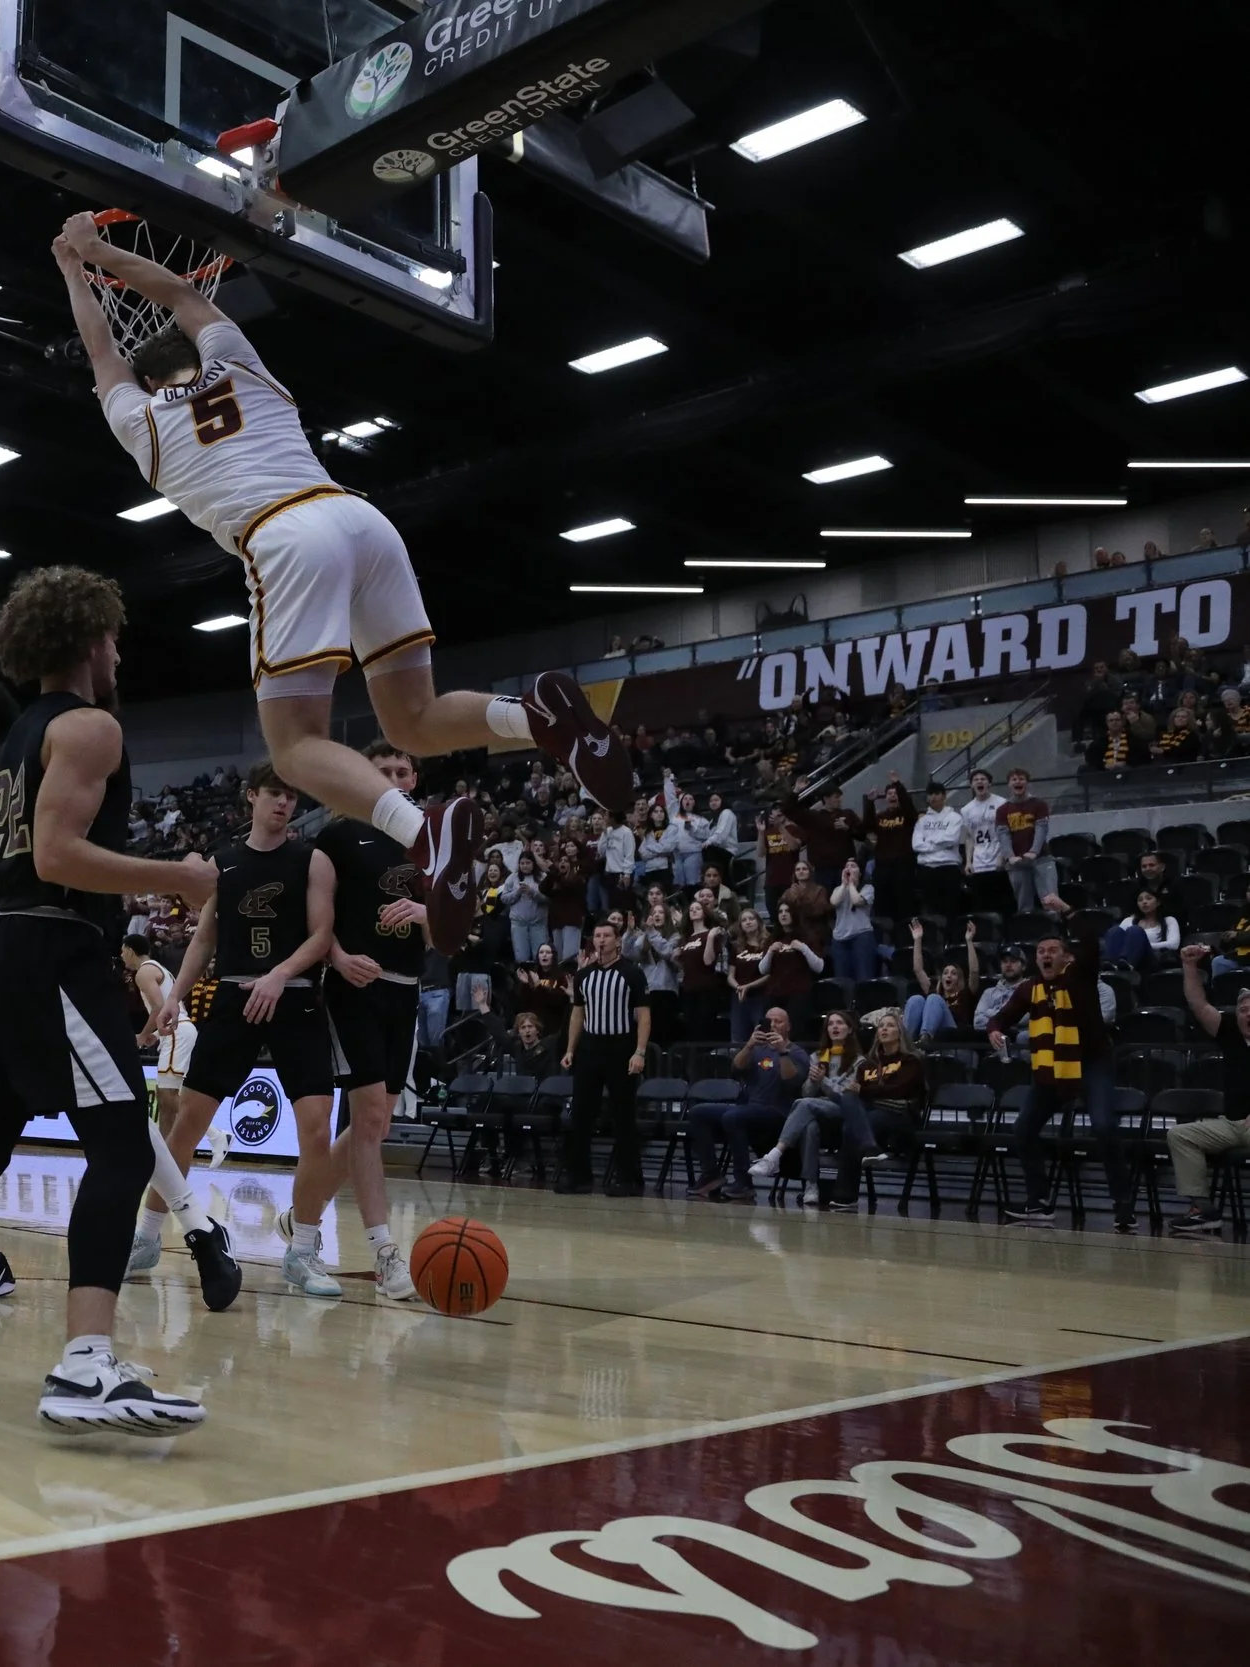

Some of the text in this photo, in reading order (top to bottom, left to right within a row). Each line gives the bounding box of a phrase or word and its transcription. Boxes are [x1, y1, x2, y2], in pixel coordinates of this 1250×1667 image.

[424, 10, 517, 76] CREDIT
[427, 57, 611, 150] GreenState
[449, 80, 602, 157] CREDIT UNION
[190, 376, 245, 448] 5
[1116, 579, 1232, 658] TO
[928, 729, 974, 753] 209
[976, 830, 991, 844] 24
[251, 927, 271, 958] 5
[243, 1084, 273, 1099] GOOSE
[238, 1123, 270, 1139] ISLAND
